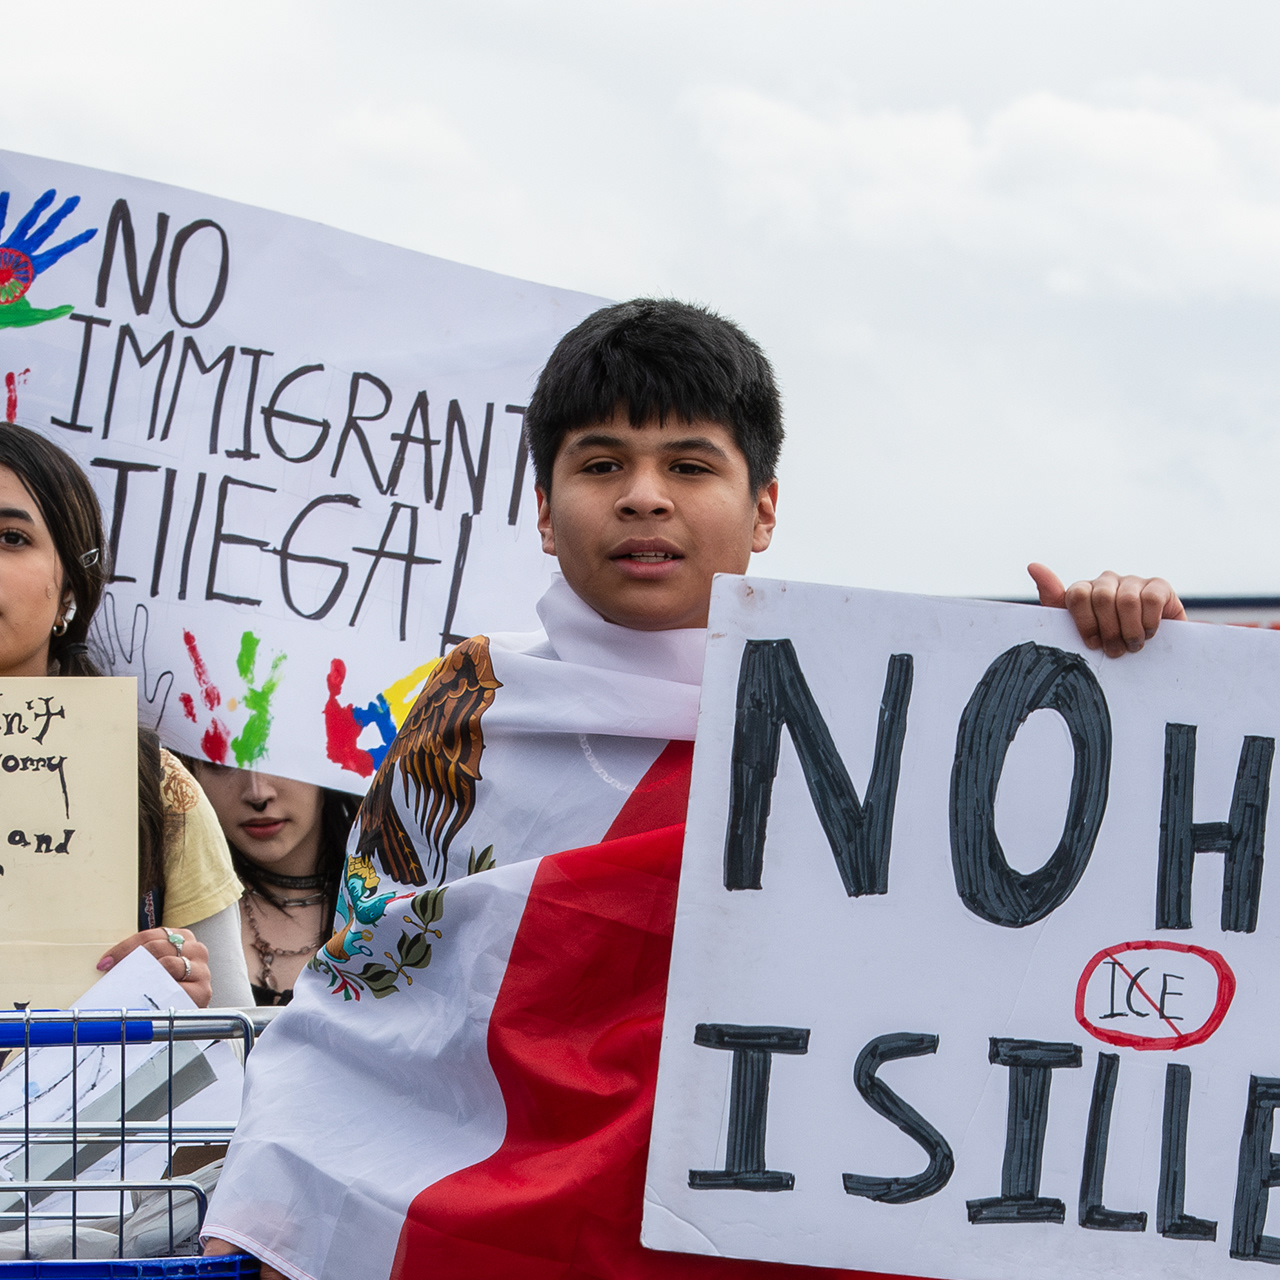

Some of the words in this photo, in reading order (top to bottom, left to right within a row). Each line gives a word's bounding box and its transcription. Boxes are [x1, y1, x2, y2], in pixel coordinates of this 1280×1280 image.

[96, 198, 230, 329] NO
[723, 637, 1113, 928] NO
[7, 828, 76, 856] and
[1099, 960, 1185, 1020] ICE
